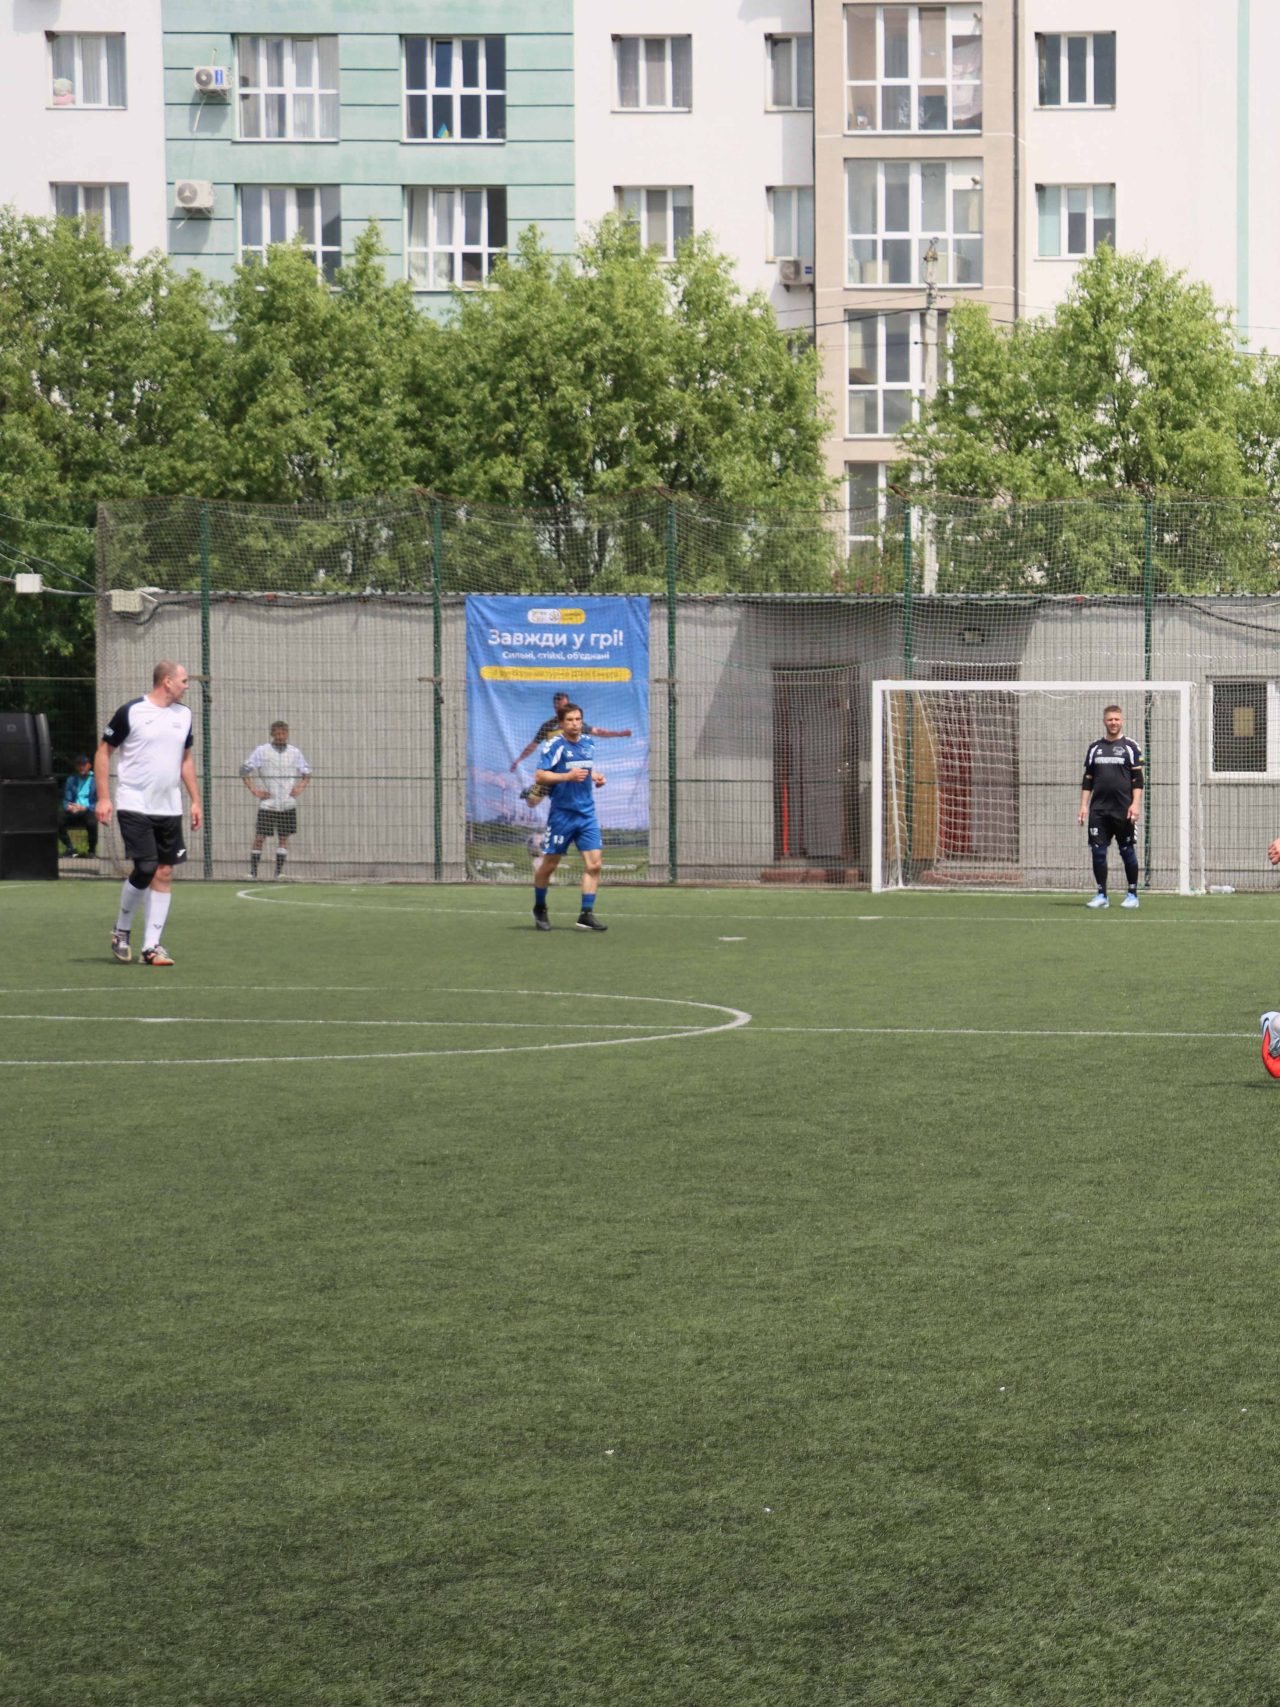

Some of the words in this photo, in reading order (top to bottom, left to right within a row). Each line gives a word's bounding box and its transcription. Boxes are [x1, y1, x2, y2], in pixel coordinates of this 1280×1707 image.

[488, 629, 568, 648] Завжди
[572, 633, 585, 649] у
[590, 629, 624, 649] грі!
